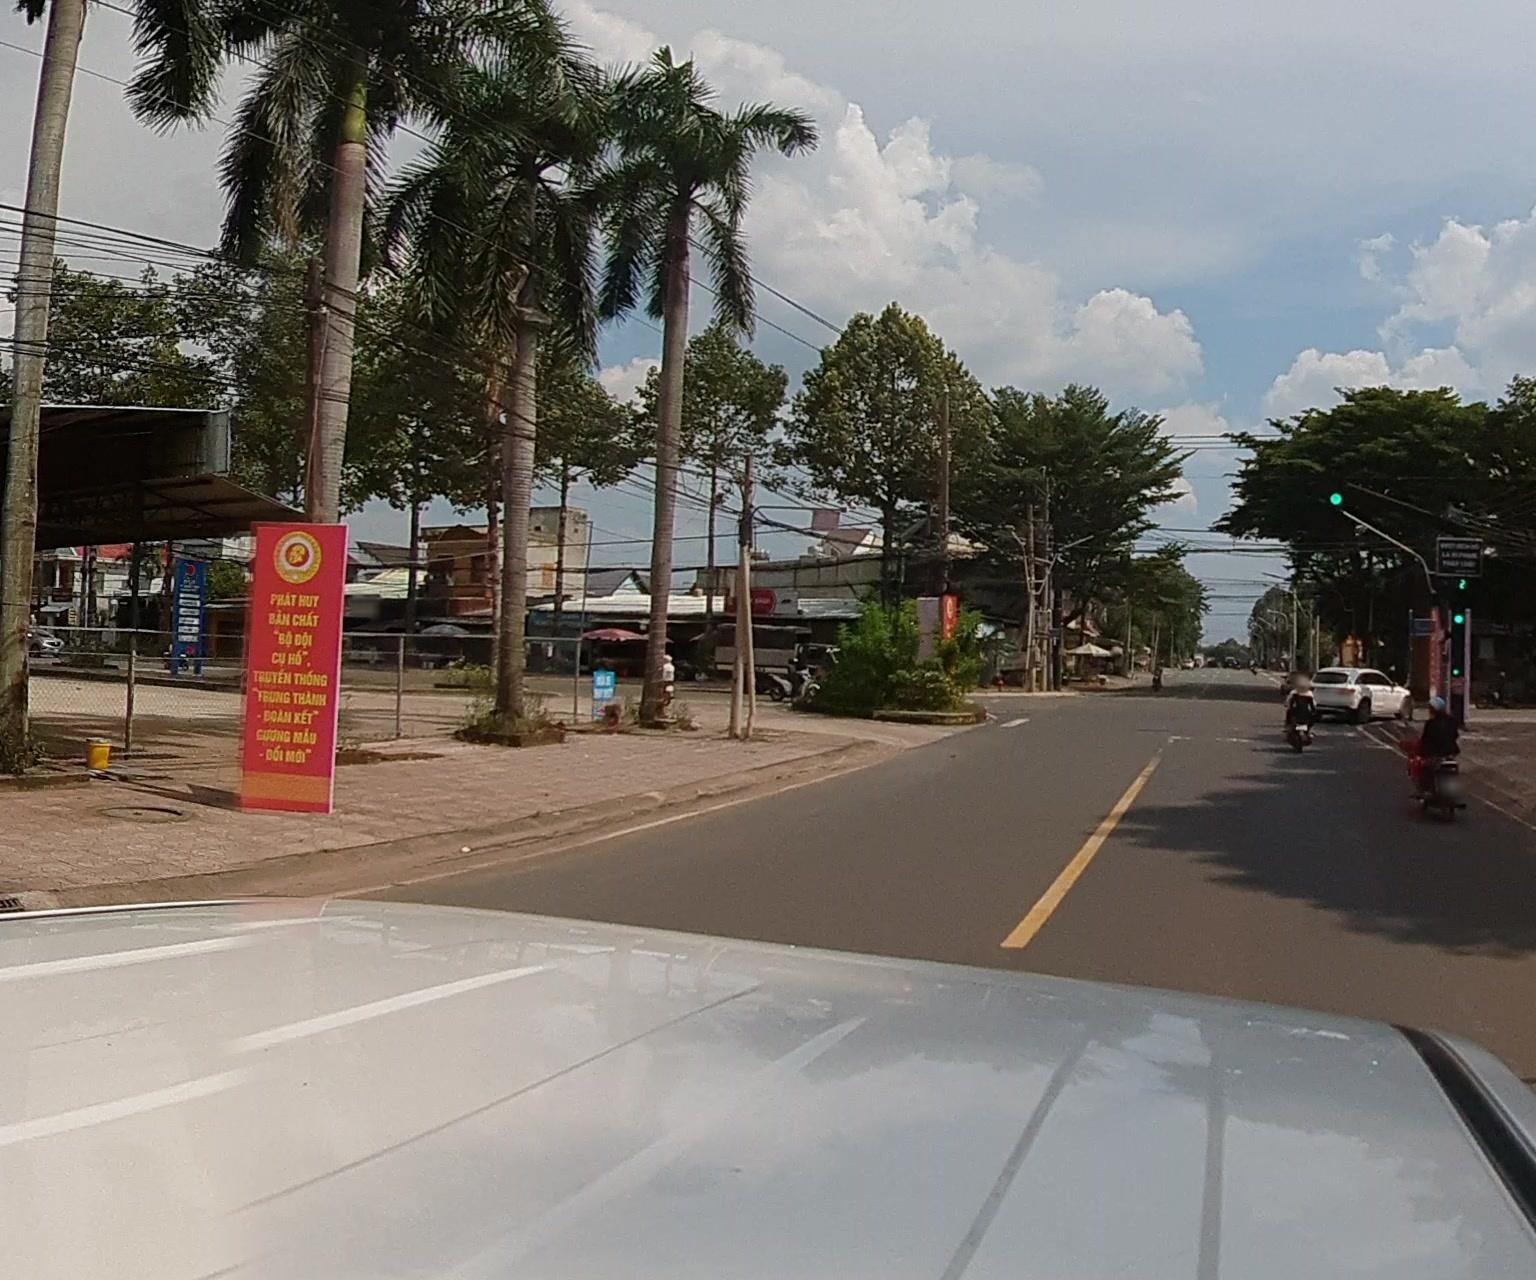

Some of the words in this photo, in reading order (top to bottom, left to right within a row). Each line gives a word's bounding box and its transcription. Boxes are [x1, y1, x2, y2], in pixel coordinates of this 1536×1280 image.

[270, 592, 296, 606] PHÁT
[298, 594, 320, 607] HUY
[269, 610, 290, 626] BẢN
[292, 611, 319, 627] CHẤT
[272, 651, 286, 667] CỤ
[253, 669, 292, 684] TRUYỀN
[294, 671, 328, 686] THỐNG
[293, 691, 327, 706] THÀNH
